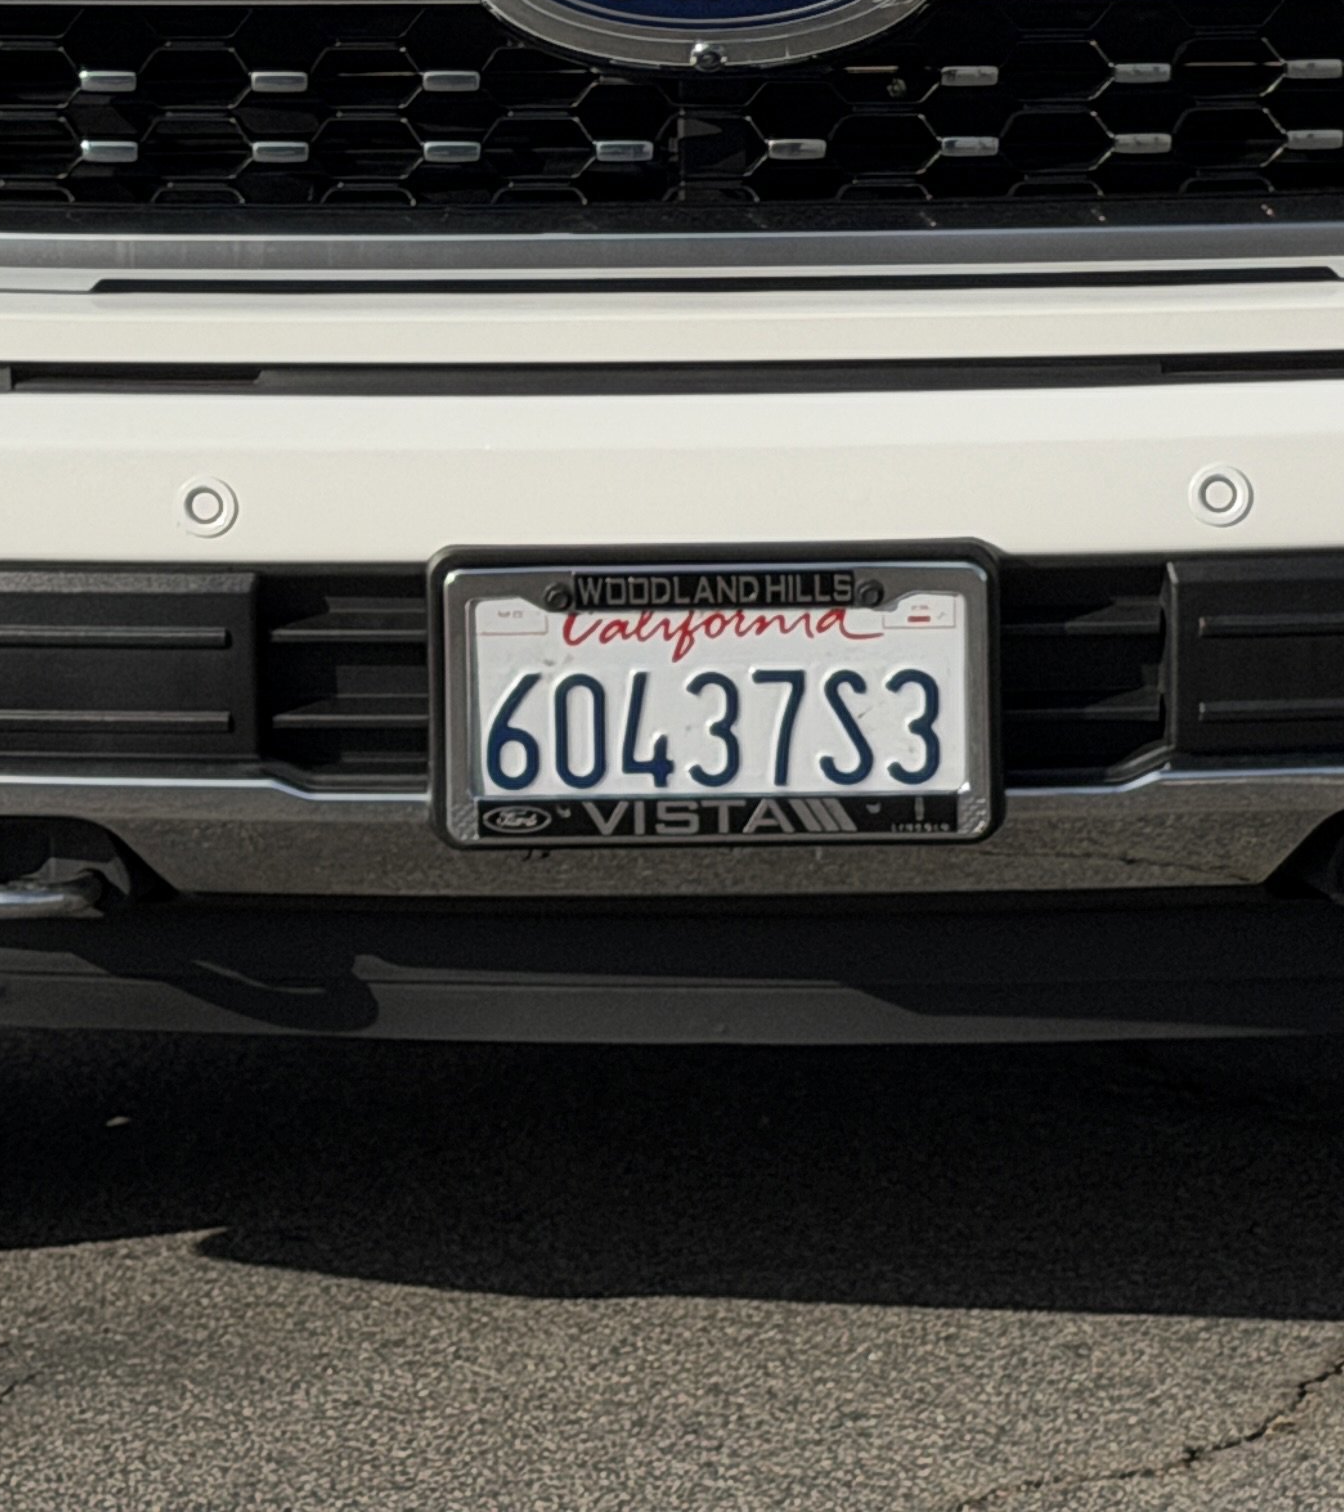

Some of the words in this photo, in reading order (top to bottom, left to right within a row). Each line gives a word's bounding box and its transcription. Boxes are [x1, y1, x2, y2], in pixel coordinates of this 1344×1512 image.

[577, 574, 760, 605] WOODLAND
[765, 573, 853, 603] HILLS
[562, 607, 885, 663] California
[486, 668, 941, 791] 60437S3
[582, 798, 795, 836] VISTA
